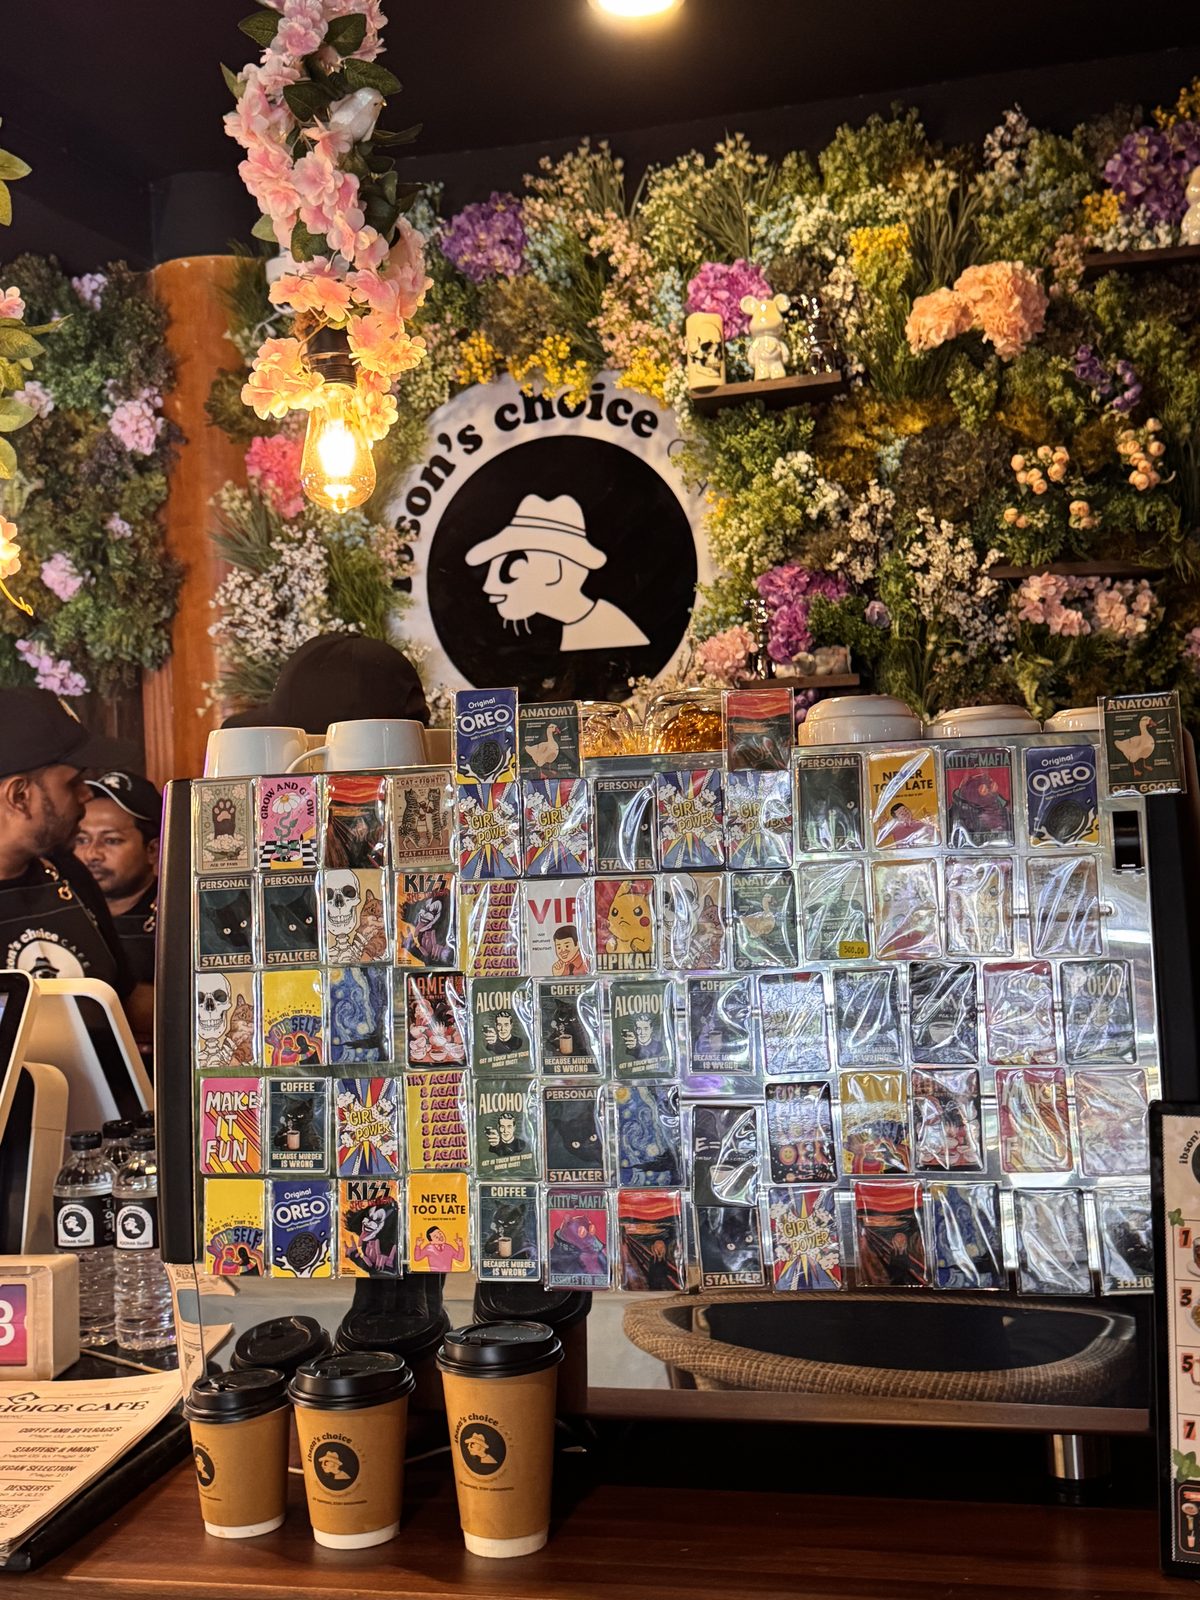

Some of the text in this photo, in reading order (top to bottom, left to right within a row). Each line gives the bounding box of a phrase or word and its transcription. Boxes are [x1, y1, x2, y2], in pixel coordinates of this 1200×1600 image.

[495, 383, 658, 438] choice
[468, 697, 495, 708] Original
[1107, 697, 1171, 710] ANATOMY
[520, 706, 574, 718] ANATOMY
[461, 709, 509, 732] OREO
[801, 758, 856, 768] PERSONAL
[946, 755, 969, 768] KITTY
[978, 753, 1010, 766] MAFIA
[1042, 754, 1073, 766] Original
[883, 769, 922, 781] NEER
[1033, 766, 1090, 791] OREO
[906, 780, 933, 790] LATE
[1140, 782, 1178, 792] GOOSE
[261, 789, 275, 819] GROW
[277, 782, 298, 792] AND
[671, 801, 700, 817] GIRL
[471, 812, 498, 830] GIRL
[539, 810, 564, 826] GIRL
[678, 811, 714, 832] POWER
[477, 828, 507, 844] POWE
[600, 859, 652, 870] STAER
[200, 879, 249, 889] PERSONAL
[265, 875, 314, 886] PERSONAL
[404, 874, 446, 893] KISS
[460, 884, 480, 894] TRY
[20, 928, 58, 943] choice
[202, 955, 251, 966] STALKER
[268, 952, 317, 962] STALKER
[484, 959, 519, 968] AGAIN
[551, 985, 586, 995] COFFEE
[407, 1073, 463, 1086] TRY AGAIN
[281, 1082, 315, 1092] COFFEE
[420, 1087, 428, 1098] &
[206, 1092, 258, 1112] MAKE
[421, 1100, 429, 1110] &
[350, 1110, 376, 1126] GIRL
[422, 1112, 429, 1123] &
[217, 1115, 237, 1137] IT
[356, 1121, 391, 1140] POWER
[422, 1124, 466, 1136] & AGAIN
[423, 1136, 467, 1148] & AGAIN
[1179, 1130, 1200, 1164] ibson'
[206, 1140, 247, 1164] FUN
[424, 1149, 467, 1161] & AGAIN
[550, 1171, 602, 1181] STALKER
[284, 1188, 311, 1199] Original
[348, 1182, 390, 1201] KISS
[491, 1187, 527, 1197] COFFEE
[422, 1194, 457, 1203] NEVER
[548, 1196, 571, 1208] KITTY
[580, 1195, 607, 1208] MAFIA
[276, 1201, 325, 1223] OREO
[413, 1205, 466, 1214] TOO LATE
[784, 1221, 813, 1238] GIRL
[792, 1231, 830, 1253] POWER
[1181, 1230, 1190, 1246] 1
[706, 1273, 760, 1286] STALKER
[1180, 1289, 1192, 1306] 3
[1182, 1356, 1193, 1372] 5
[0, 1401, 149, 1412] HOICE CAFE
[468, 1413, 499, 1426] choice
[1185, 1422, 1195, 1438] 7
[322, 1433, 352, 1444] choice
